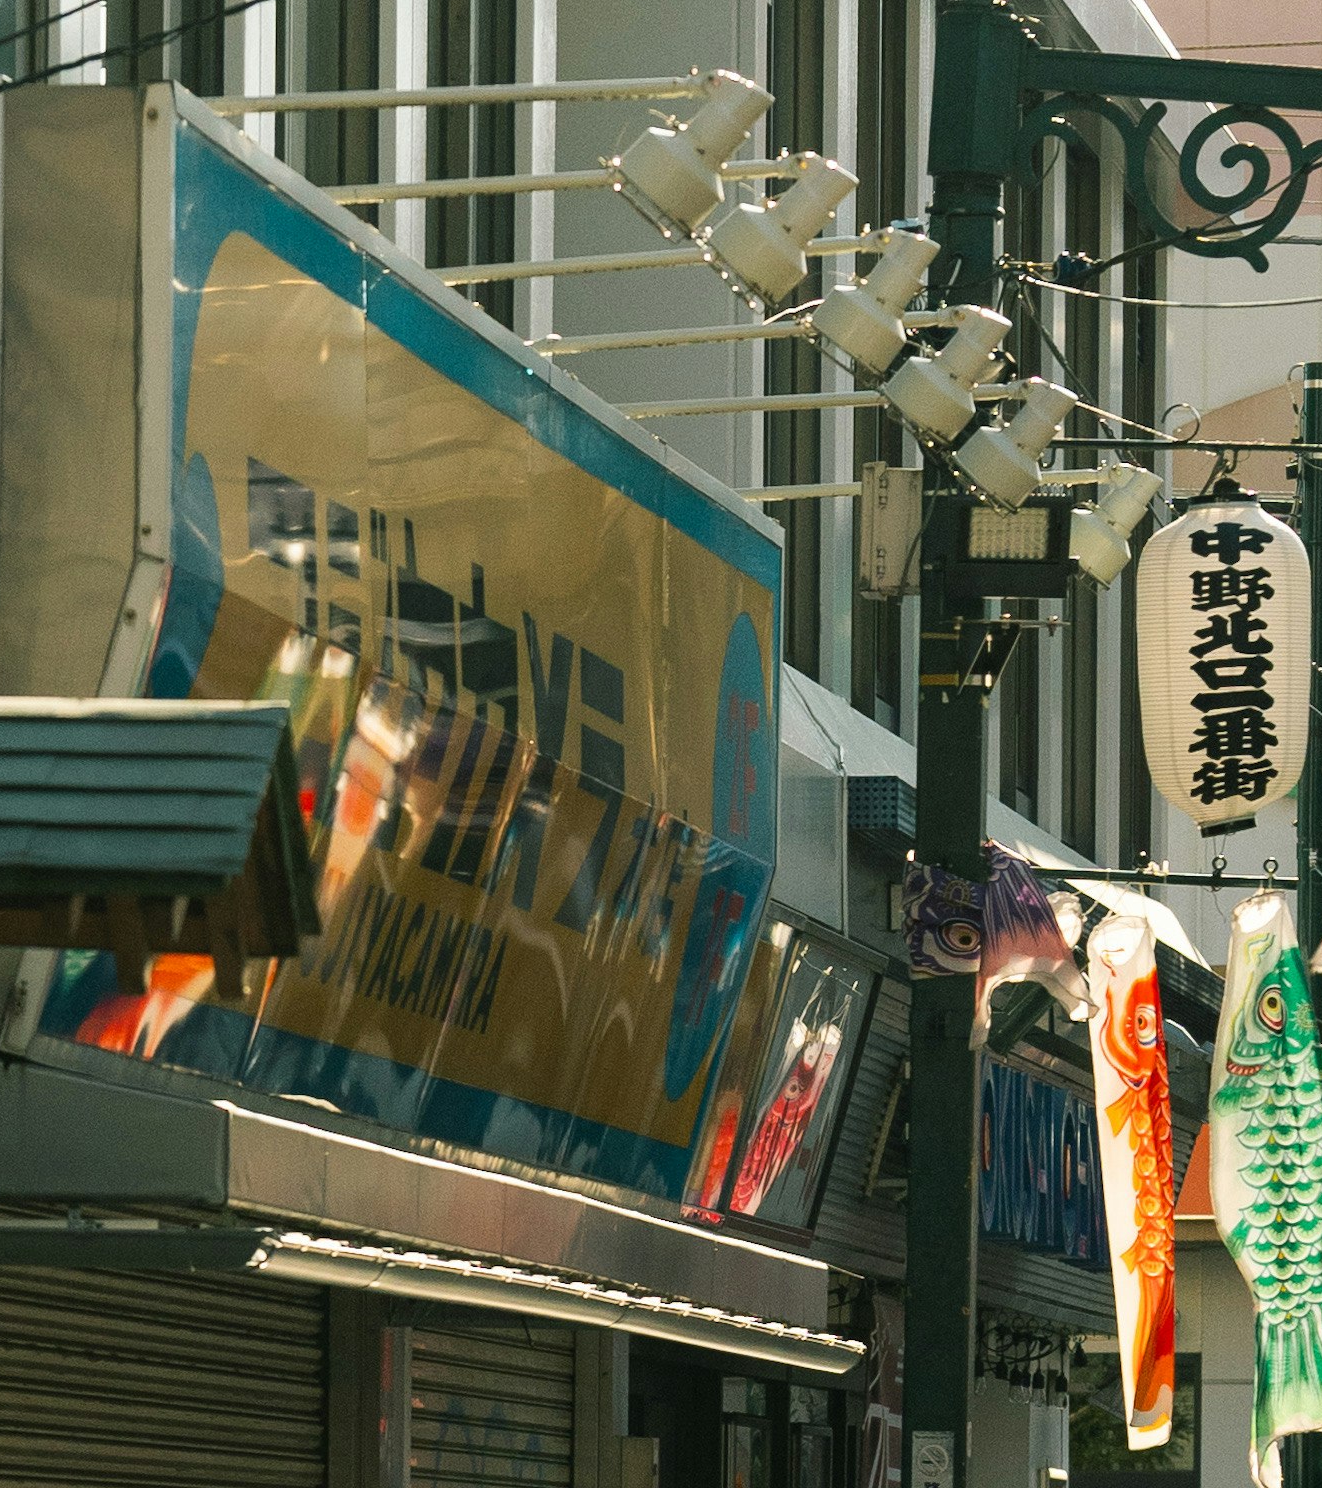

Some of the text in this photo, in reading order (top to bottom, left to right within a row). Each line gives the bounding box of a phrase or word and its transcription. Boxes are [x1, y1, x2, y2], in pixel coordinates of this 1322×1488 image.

[1188, 521, 1279, 806] 中野北口一番街
